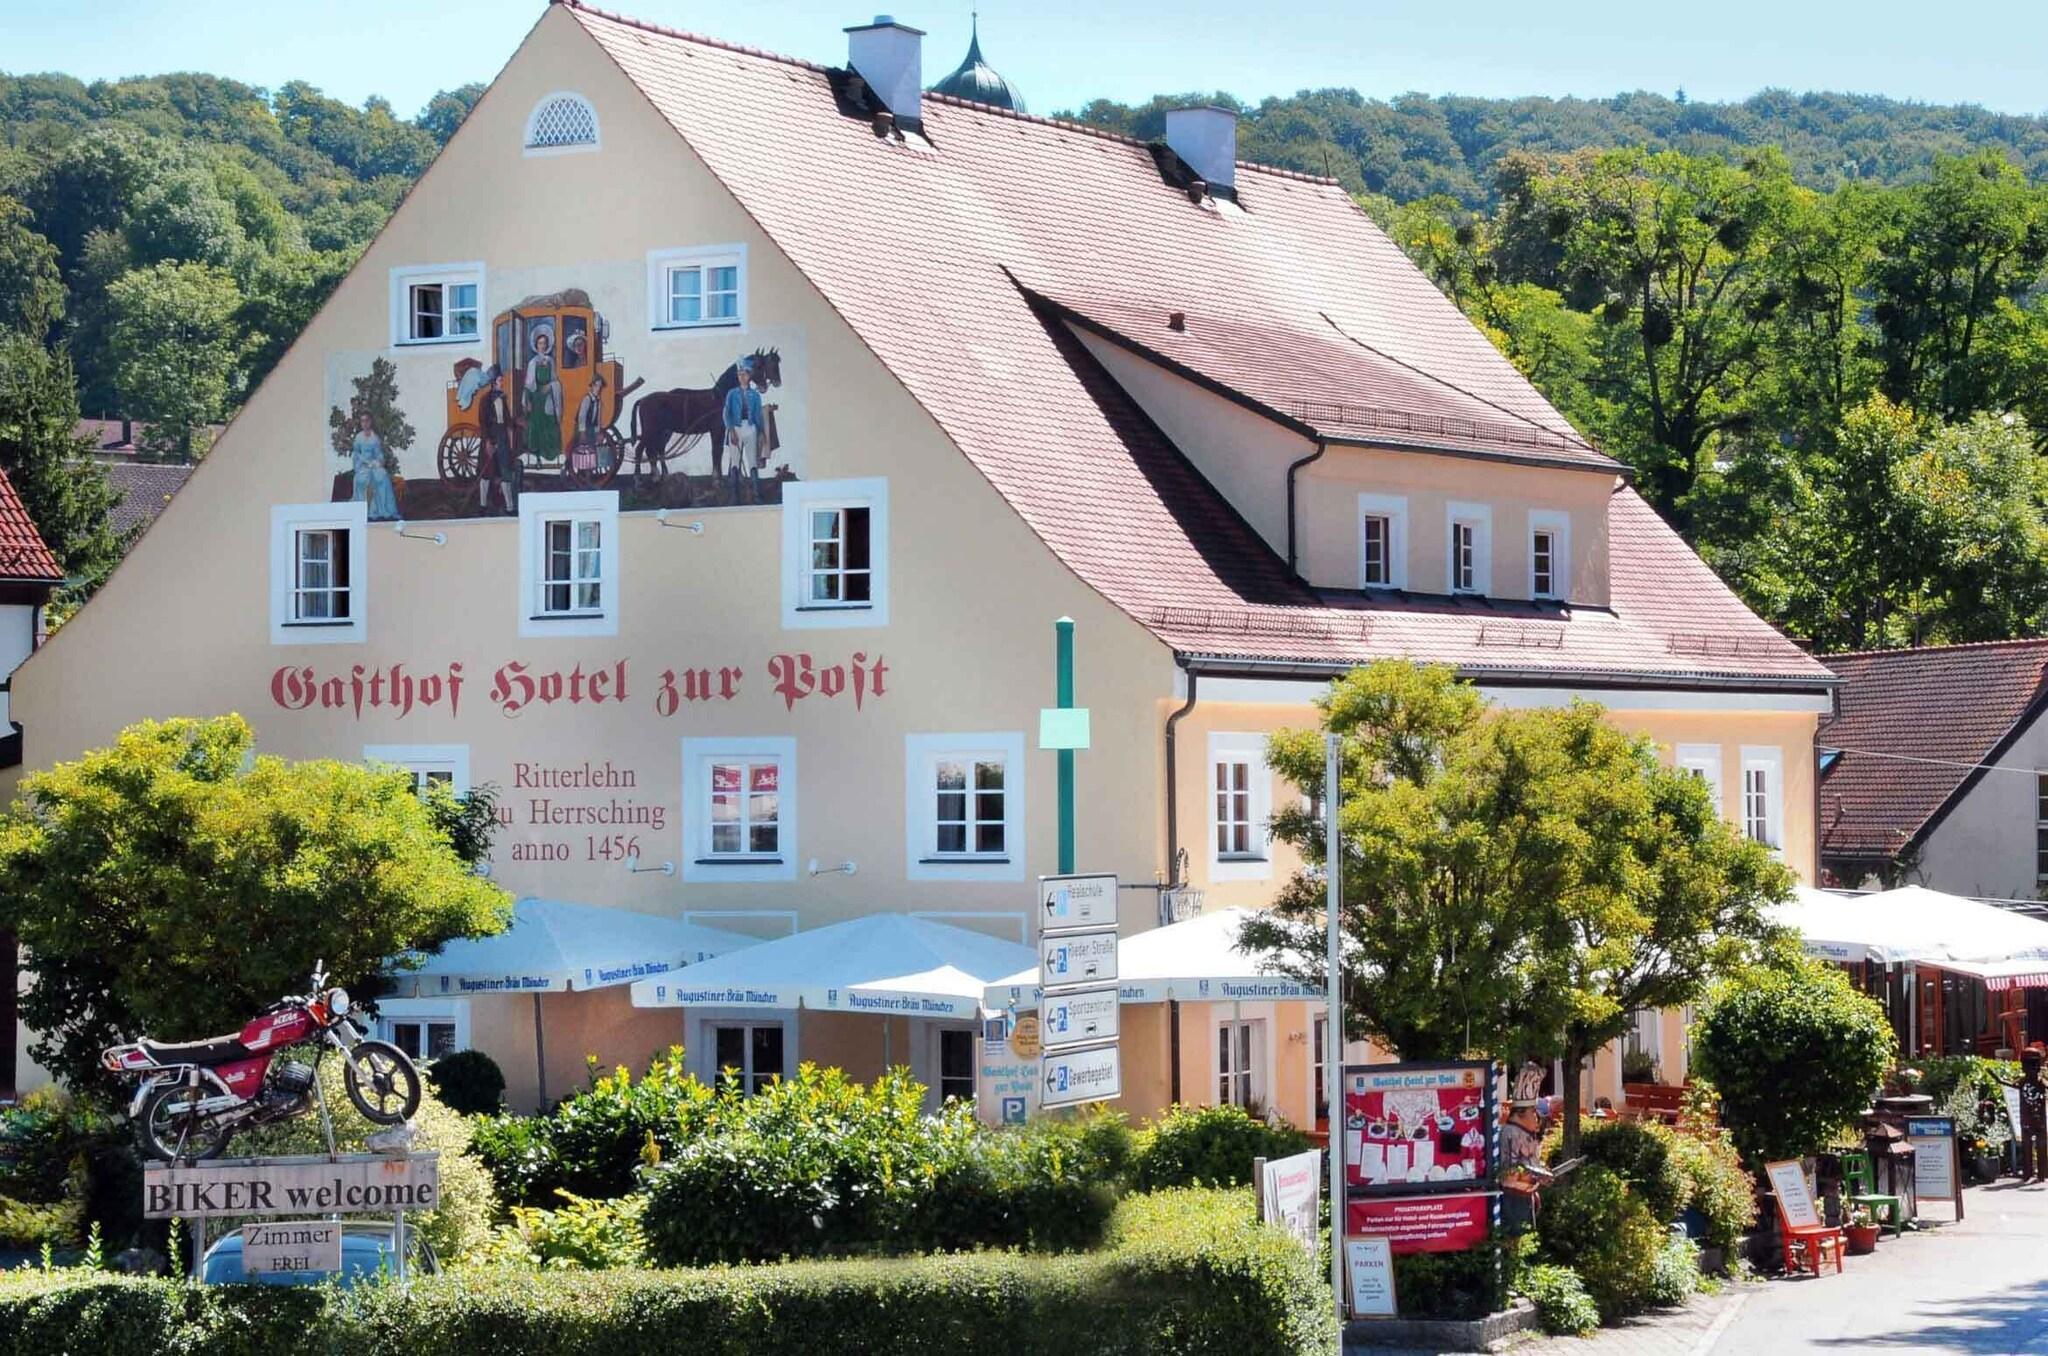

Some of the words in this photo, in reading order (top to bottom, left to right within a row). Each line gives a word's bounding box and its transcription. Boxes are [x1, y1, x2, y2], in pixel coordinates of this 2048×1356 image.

[271, 663, 465, 721] Gasthof
[490, 656, 632, 719] Hotel
[654, 665, 743, 717] zur
[767, 651, 890, 712] Post
[512, 761, 637, 788] Ritterlehn
[529, 798, 666, 830] Herrsching
[512, 841, 570, 861] anno
[586, 835, 641, 862] 1456
[1068, 1063, 1114, 1087] Gewerbegebiet
[146, 1181, 276, 1213] BIKER
[286, 1178, 433, 1209] welcome
[248, 1226, 333, 1246] Zimmer
[272, 1257, 310, 1271] FREI
